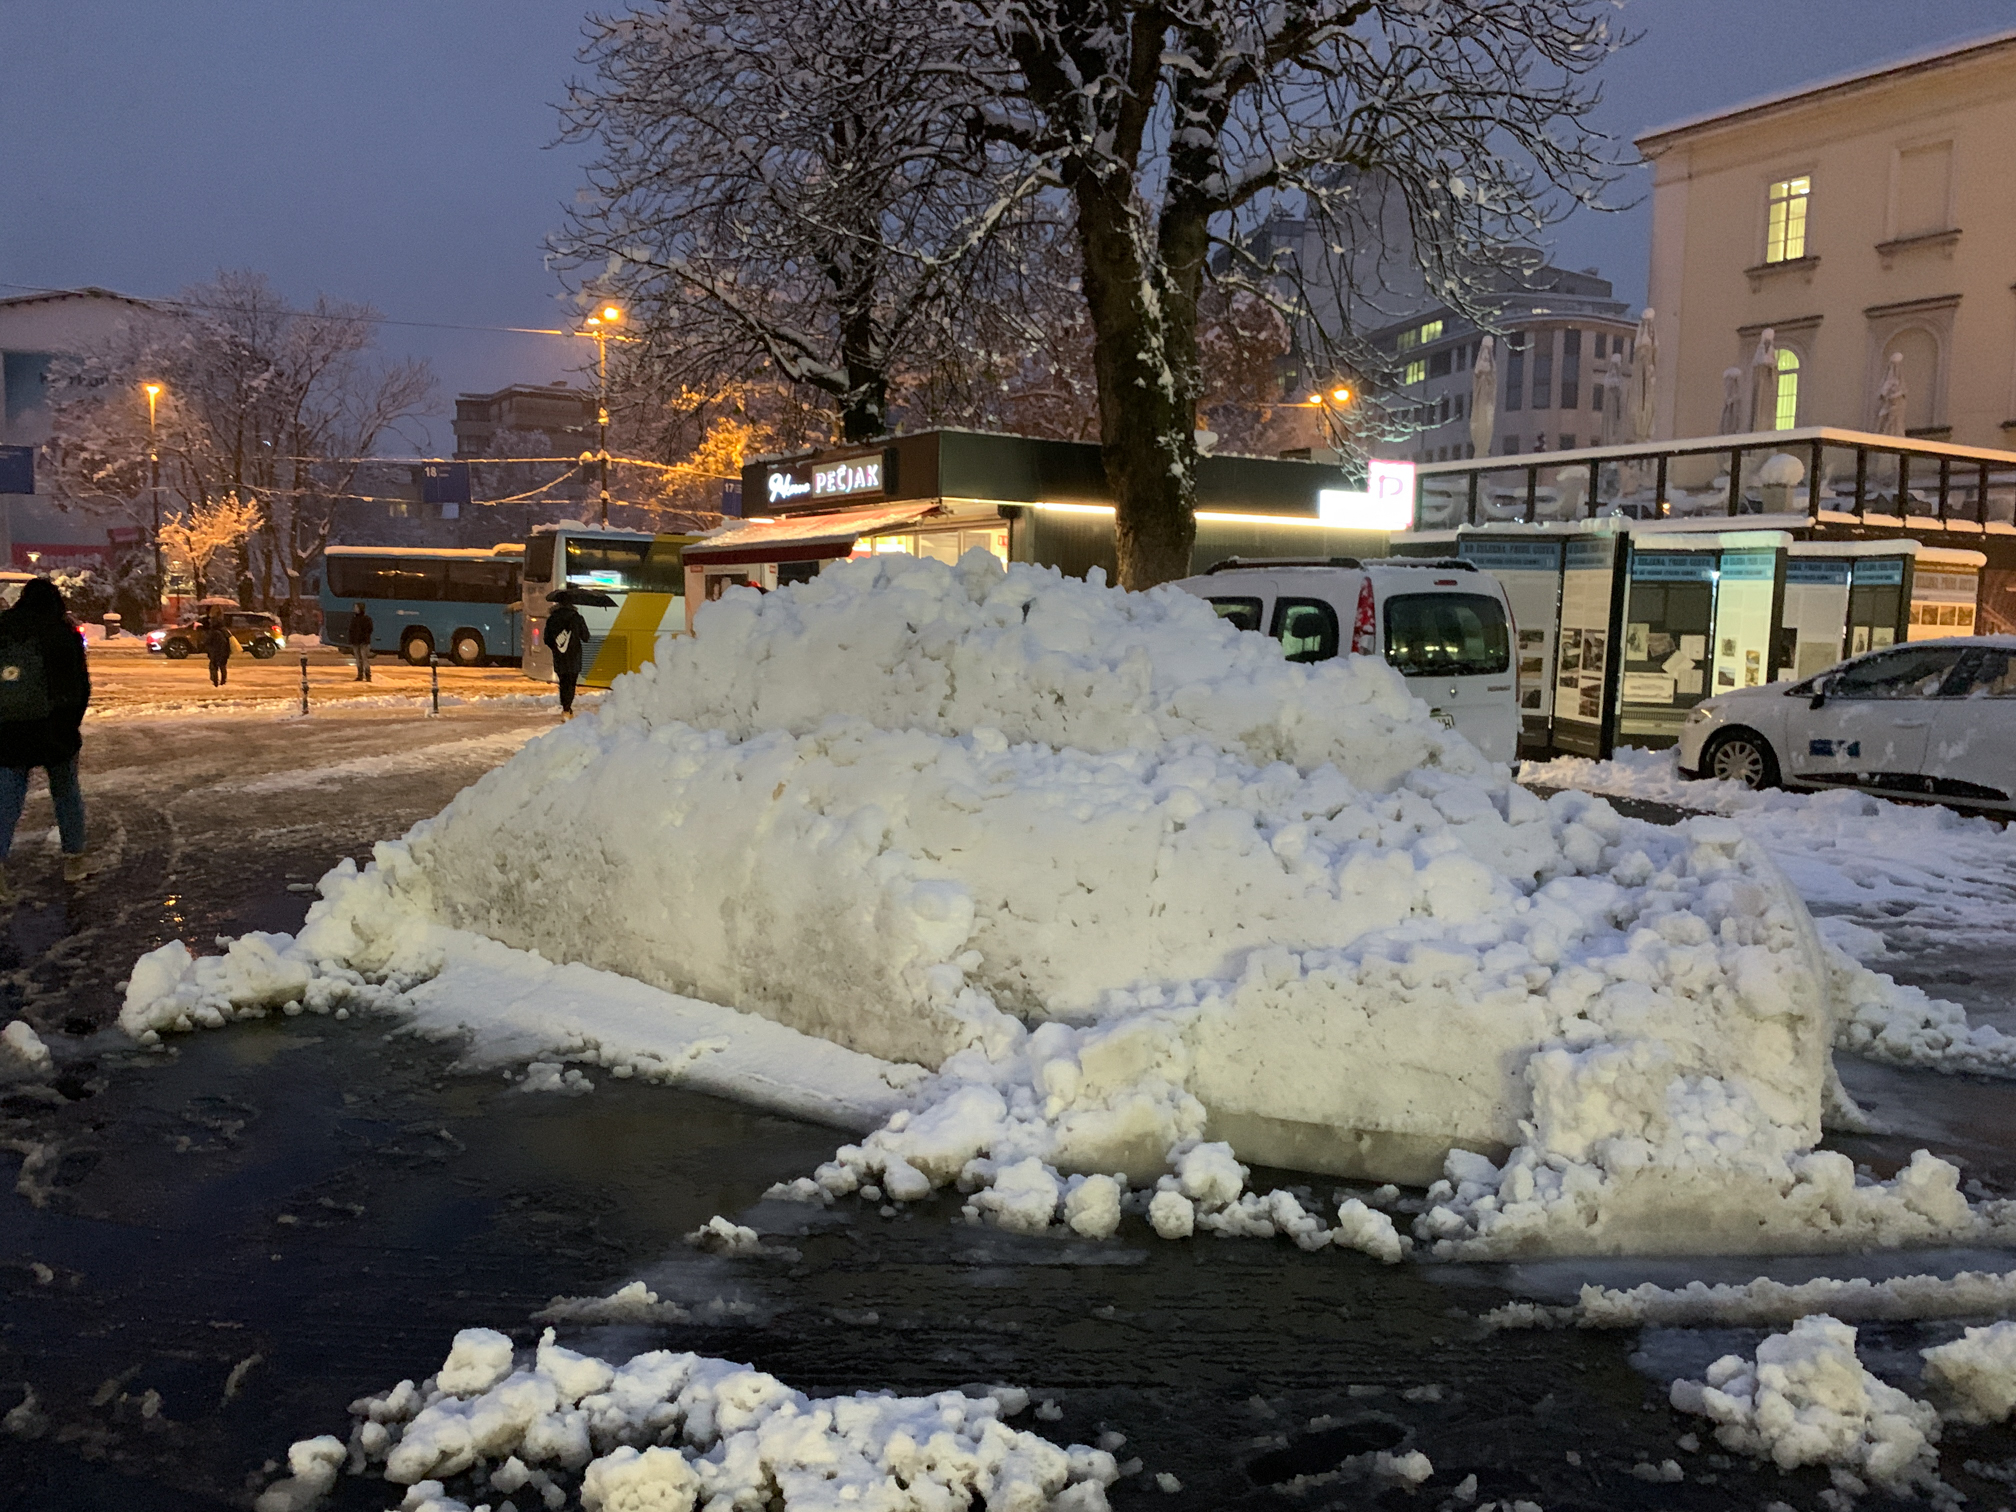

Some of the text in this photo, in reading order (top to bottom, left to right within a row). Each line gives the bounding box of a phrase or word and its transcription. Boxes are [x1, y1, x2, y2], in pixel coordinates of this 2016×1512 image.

[424, 466, 438, 478] 18
[815, 464, 879, 494] PEČJAK
[724, 482, 735, 494] 17
